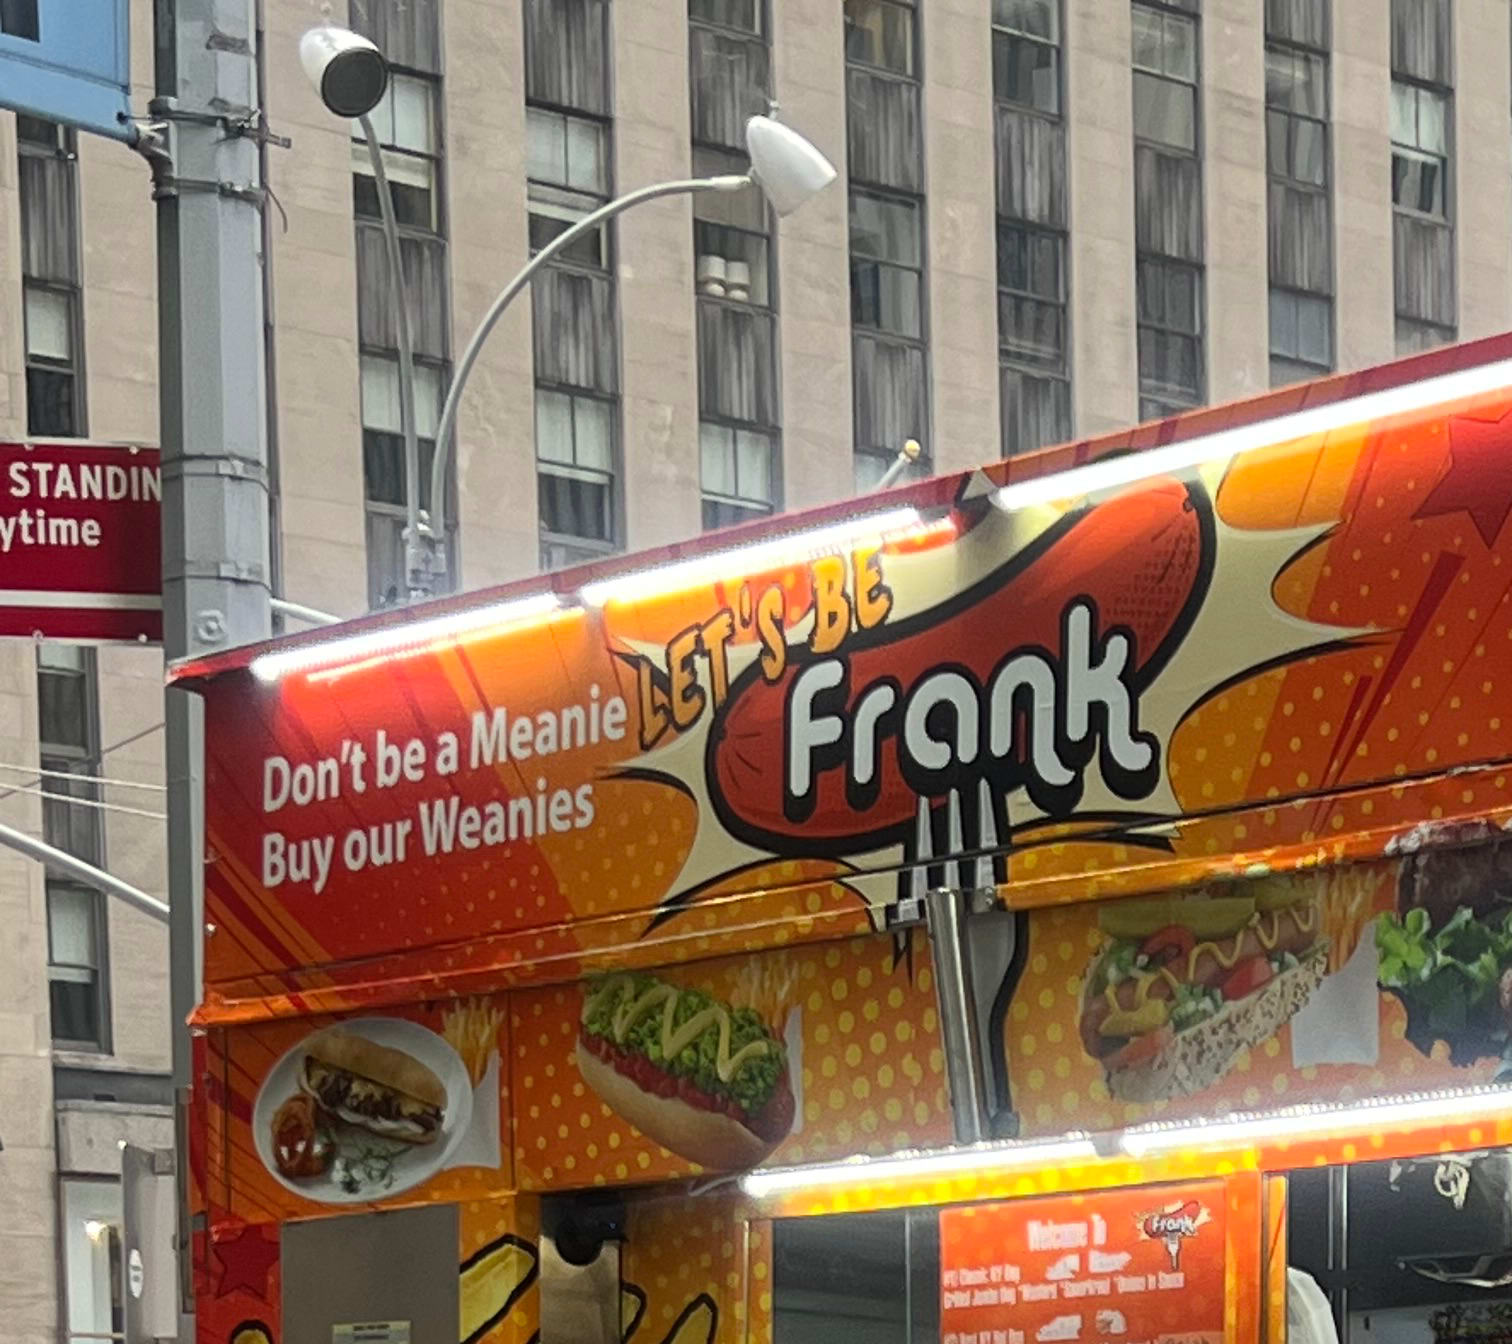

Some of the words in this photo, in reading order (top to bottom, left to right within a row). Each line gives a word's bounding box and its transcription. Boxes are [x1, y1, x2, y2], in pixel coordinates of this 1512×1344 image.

[9, 462, 162, 501] STANDIN
[635, 585, 787, 749] LET'S
[809, 544, 893, 655] BE
[791, 604, 1152, 799] Frank
[263, 739, 367, 811] Don't
[376, 729, 423, 782] be
[438, 733, 457, 772] a
[471, 688, 627, 755] Meanie
[263, 831, 334, 893] Buy
[345, 817, 411, 868] our
[420, 778, 594, 852] Weanies
